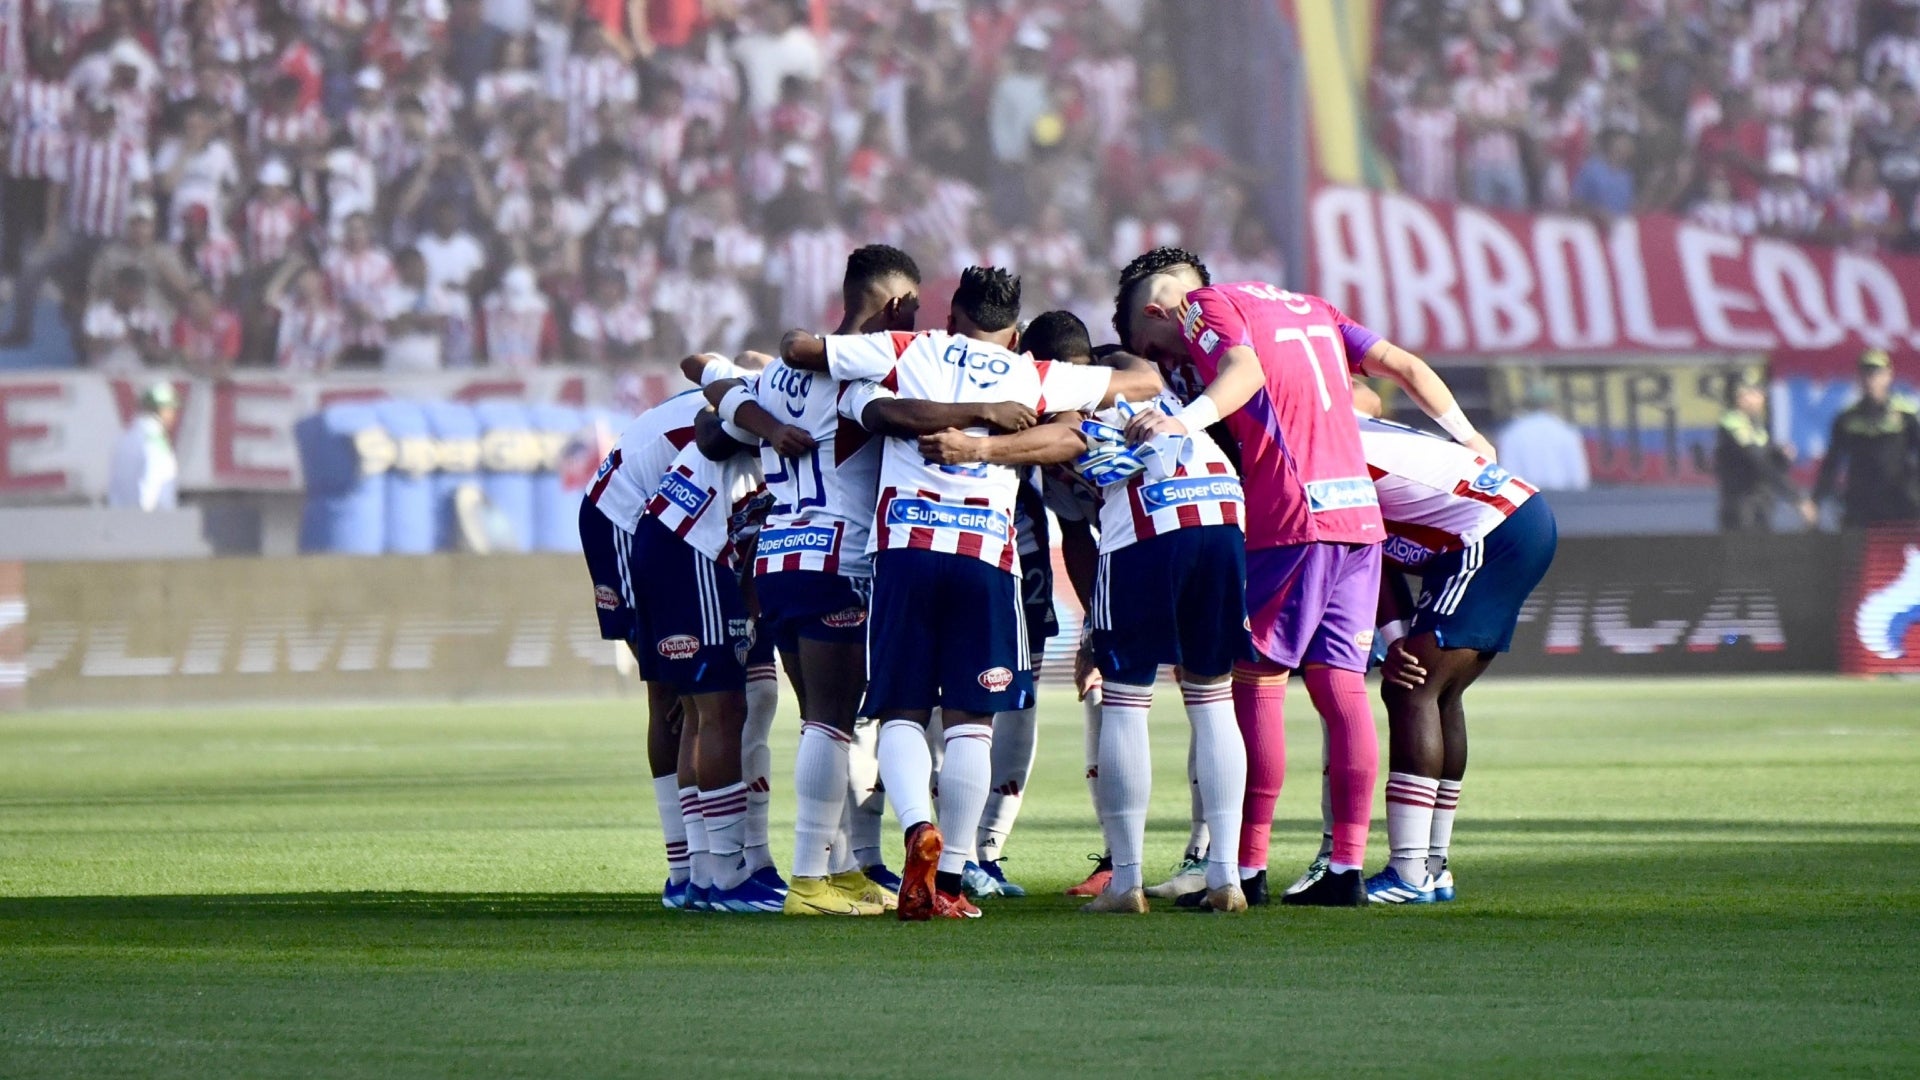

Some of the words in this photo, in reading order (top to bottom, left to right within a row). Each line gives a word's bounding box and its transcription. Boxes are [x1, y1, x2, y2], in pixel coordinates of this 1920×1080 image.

[1275, 325, 1350, 412] 77
[1517, 583, 1787, 654] ICA
[661, 637, 700, 653] Pedialyte
[670, 652, 694, 661] Active
